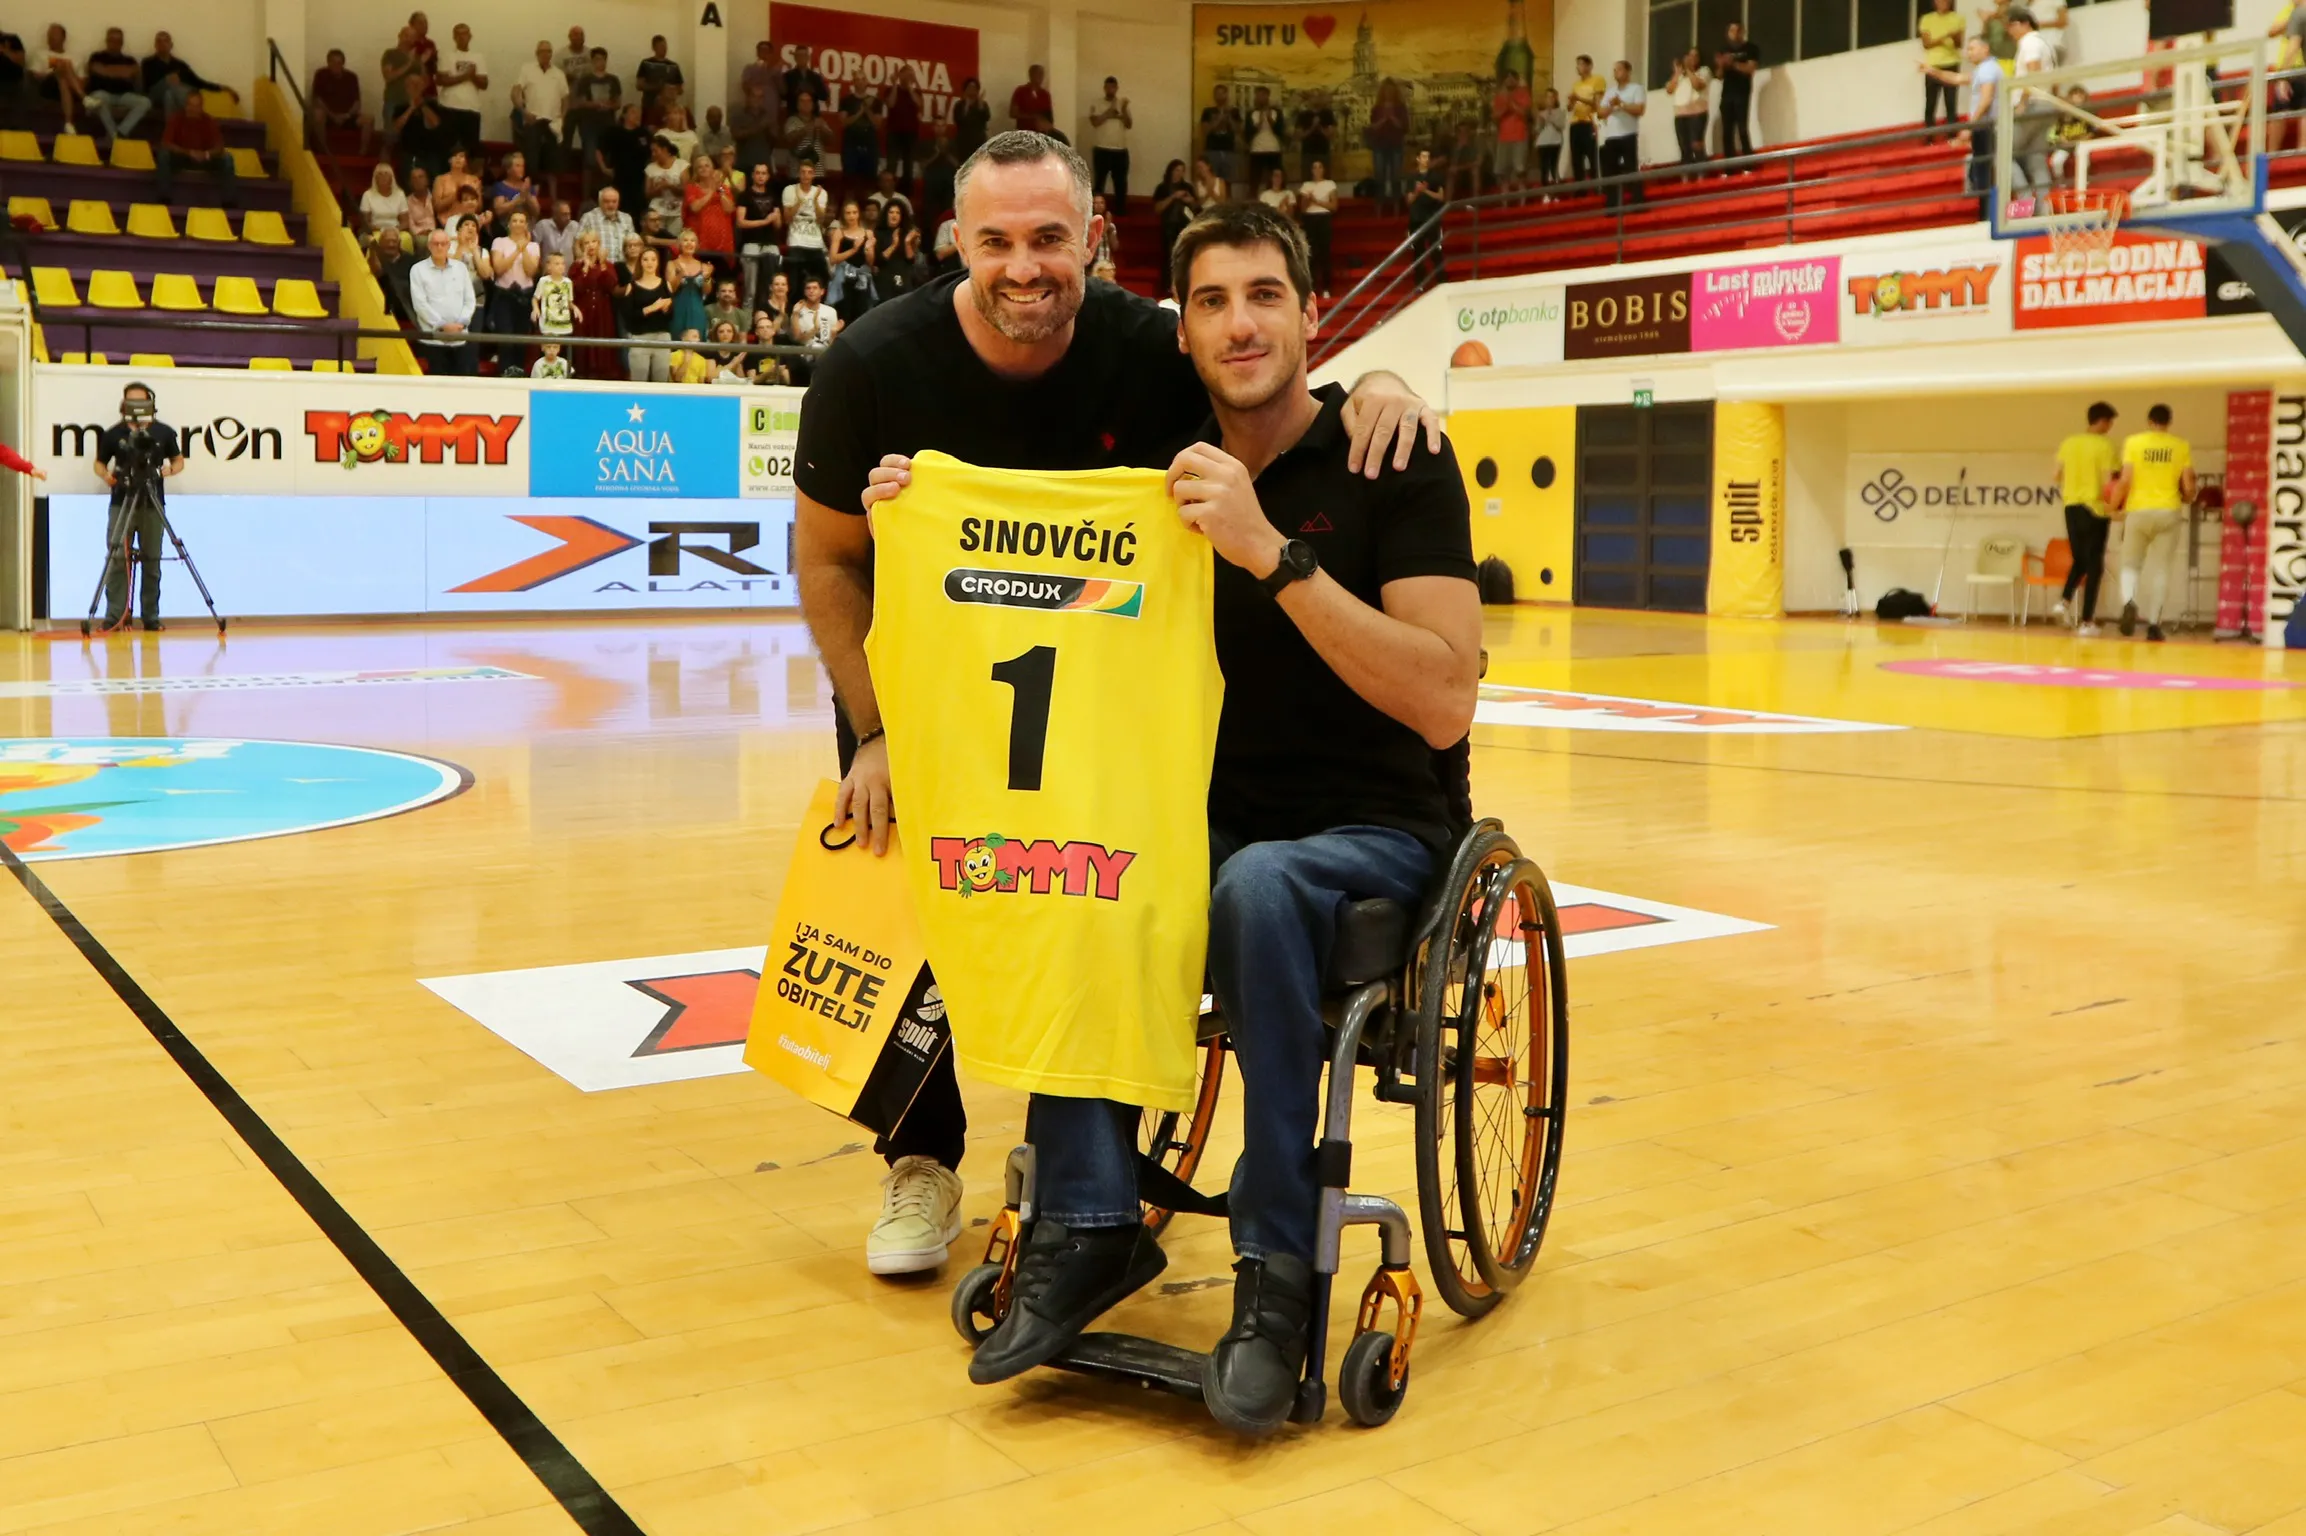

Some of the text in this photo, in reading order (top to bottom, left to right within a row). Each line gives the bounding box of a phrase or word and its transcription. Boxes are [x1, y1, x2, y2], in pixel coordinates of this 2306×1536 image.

[701, 2, 722, 27] A
[1217, 24, 1295, 46] SPLIT U
[1706, 263, 1826, 292] Last minute
[1799, 278, 1823, 293] CAR
[1848, 264, 2000, 316] TOMMY
[2021, 269, 2206, 310] DALMACIJA
[1479, 299, 1559, 331] otpbanka
[1571, 290, 1687, 329] BOBIS
[52, 415, 282, 460] mron
[305, 409, 525, 468] TOMMY
[595, 430, 675, 457] AQUA
[597, 457, 676, 482] SANA
[1724, 478, 1764, 542] split
[960, 517, 1137, 567] SINOVČIĆ
[594, 580, 780, 592] ALATI
[960, 576, 1062, 601] CRODUX
[991, 645, 1057, 791] 1
[931, 832, 1137, 901] TOMMY
[796, 922, 893, 970] I JA SAM DIO
[783, 935, 886, 1009] ŽUTE
[777, 978, 871, 1033] OBITELJI
[898, 1018, 938, 1055] split
